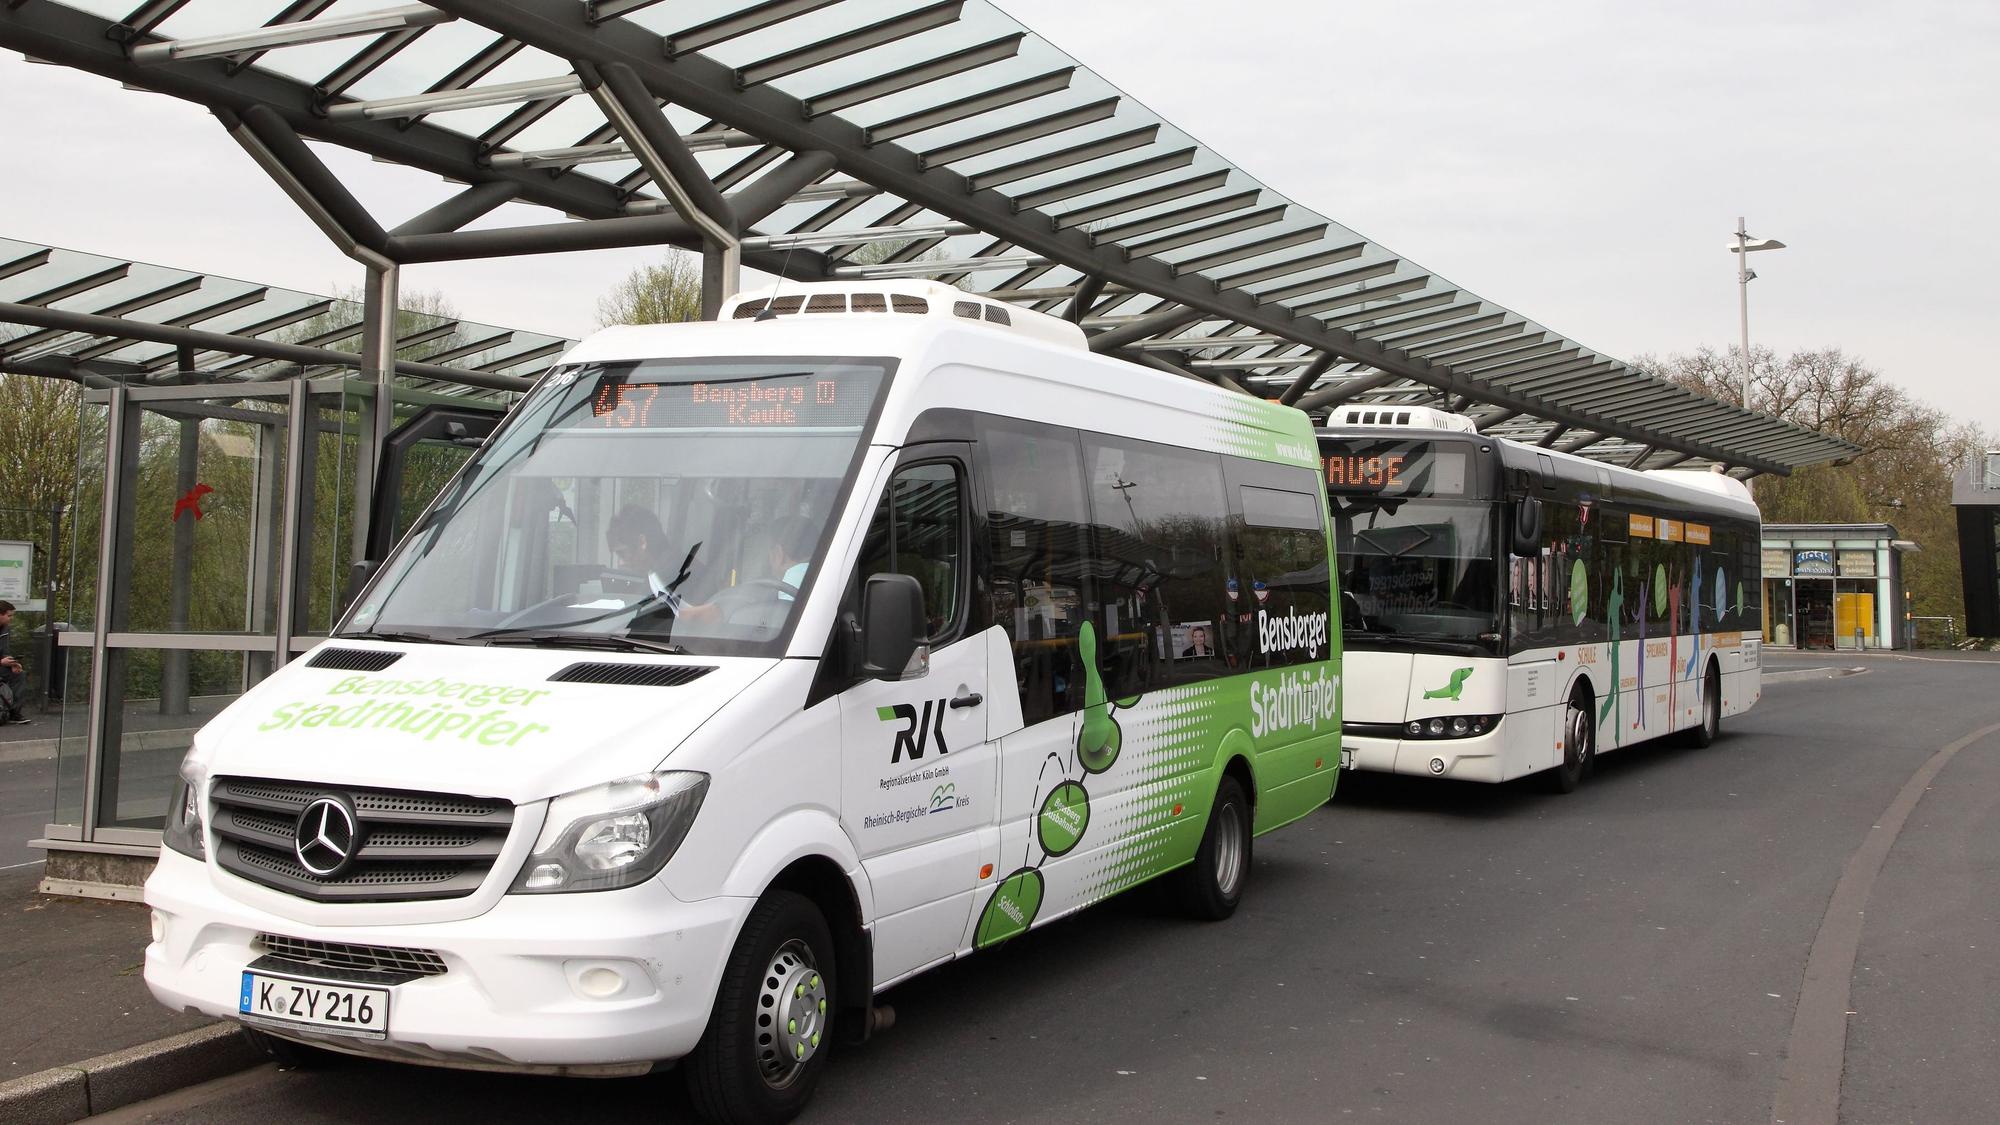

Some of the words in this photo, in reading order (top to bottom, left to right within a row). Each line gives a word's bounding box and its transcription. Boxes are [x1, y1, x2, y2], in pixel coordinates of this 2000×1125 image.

[544, 371, 578, 388] 216
[594, 384, 659, 427] 457
[692, 382, 804, 405] Bensberg
[728, 405, 796, 424] Kaule
[1796, 551, 1830, 564] KIOSK
[1258, 605, 1328, 659] Bensberger
[1577, 646, 1597, 665] SCHULE
[326, 676, 551, 707] Bensberger
[1250, 666, 1340, 738] Stadthüpfer
[258, 699, 550, 747] Stadthüpfer
[880, 773, 922, 790] Regionalverkehr
[922, 769, 934, 780] Köln
[934, 766, 950, 778] GmbH
[864, 805, 928, 829] Rheinisch-Bergischer
[956, 795, 970, 808] Kreis
[1043, 807, 1081, 838] Busbahnhof
[1054, 798, 1081, 825] Bensberg
[243, 996, 249, 1006] D
[260, 981, 274, 1012] K
[289, 986, 320, 1019] ZY
[325, 991, 373, 1025] 216
